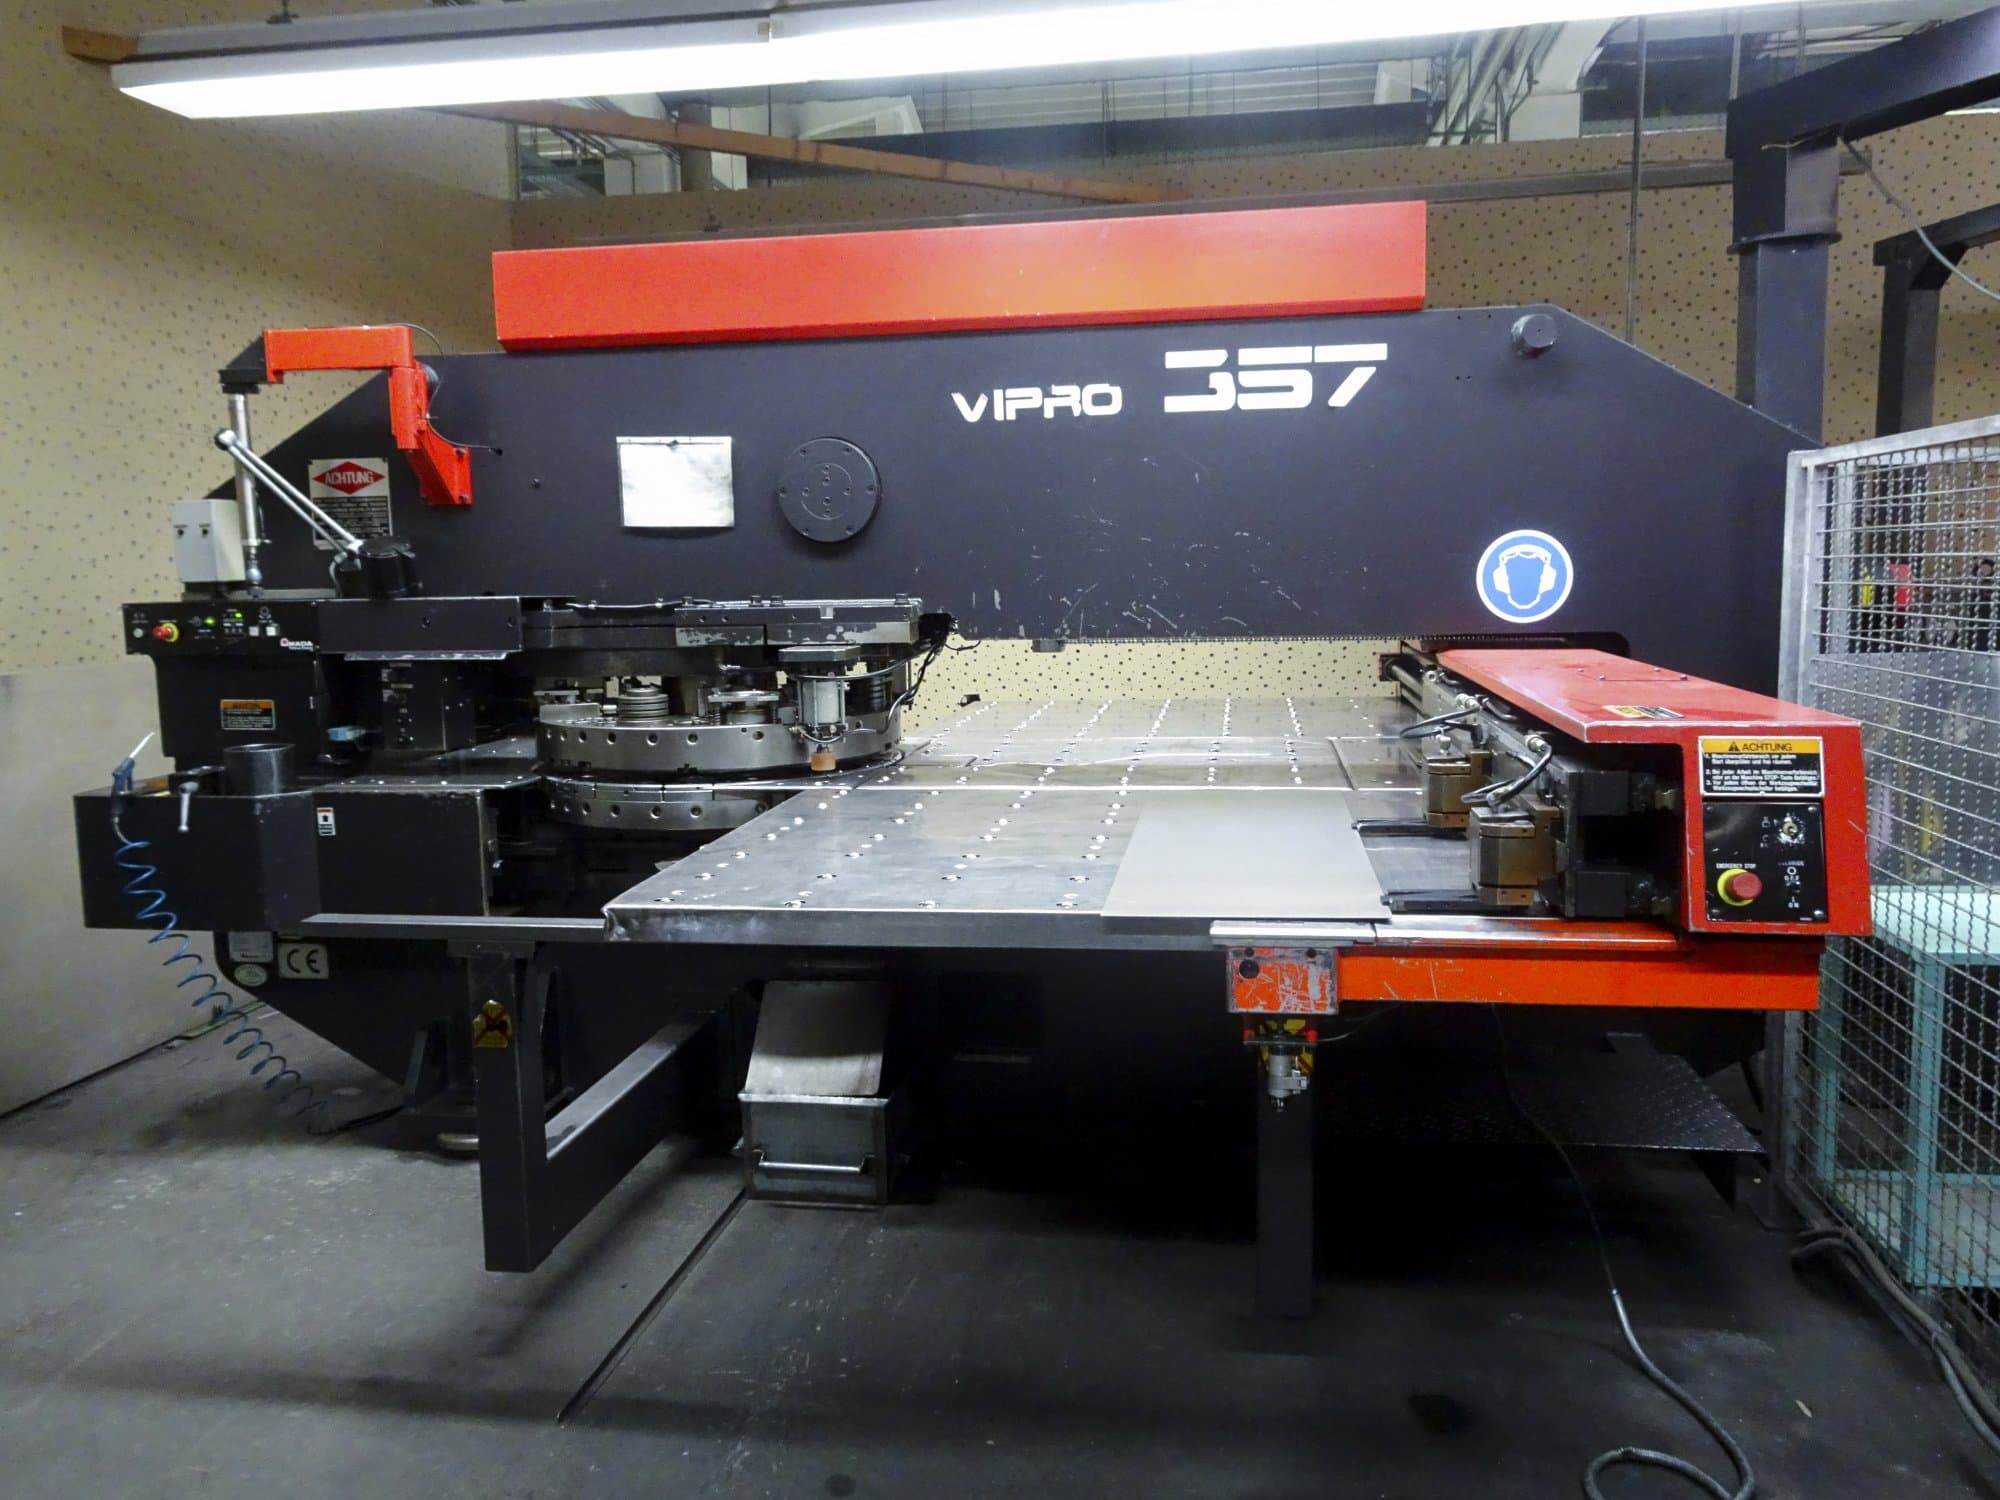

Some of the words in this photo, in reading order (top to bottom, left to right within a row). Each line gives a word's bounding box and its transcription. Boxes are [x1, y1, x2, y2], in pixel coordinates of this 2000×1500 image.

[951, 384, 1123, 422] VIPRO
[1164, 343, 1388, 413] 357
[325, 471, 374, 485] ACHTUNG
[1742, 742, 1792, 752] ACHTUNG
